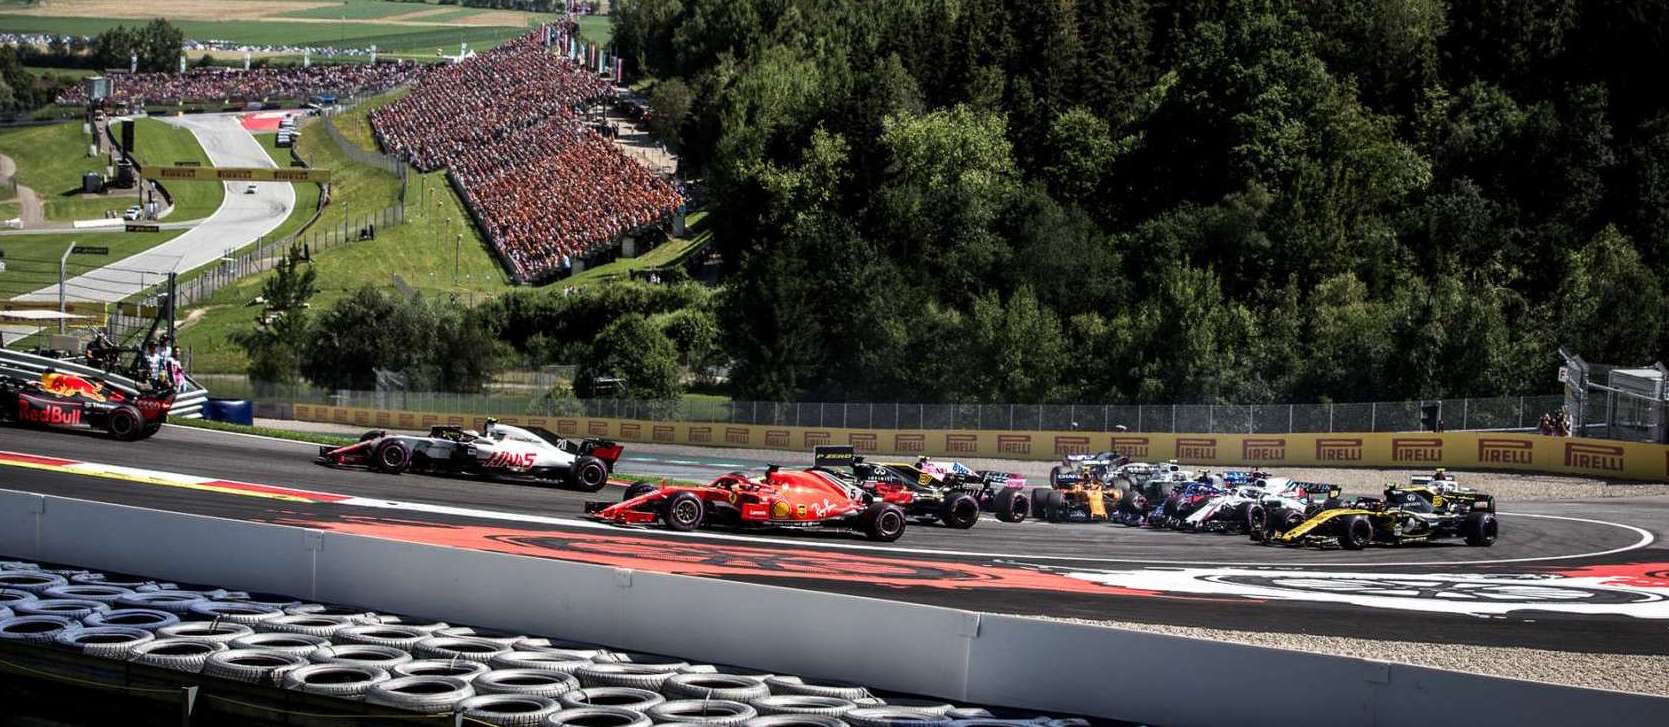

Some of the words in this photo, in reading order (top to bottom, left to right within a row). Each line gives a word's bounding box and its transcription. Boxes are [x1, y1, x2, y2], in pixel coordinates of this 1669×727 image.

[19, 399, 50, 422] Red
[52, 405, 81, 425] Bull
[556, 438, 567, 450] 20
[895, 434, 925, 452] PIRELLI
[946, 434, 977, 452] PIRELLI
[998, 435, 1031, 454] PIRELLI
[1055, 436, 1090, 455] PIRELLI
[1111, 437, 1149, 458] PIRELLI
[1176, 438, 1216, 459] PIRELLI
[1242, 439, 1286, 460] PIRELLI
[1315, 438, 1362, 461] PIRELLI
[1392, 438, 1443, 462] PIRELLI
[1478, 438, 1533, 464] PIRELLI
[1564, 442, 1624, 472] PIRELLI
[483, 451, 537, 469] HAAS
[850, 490, 856, 500] 5
